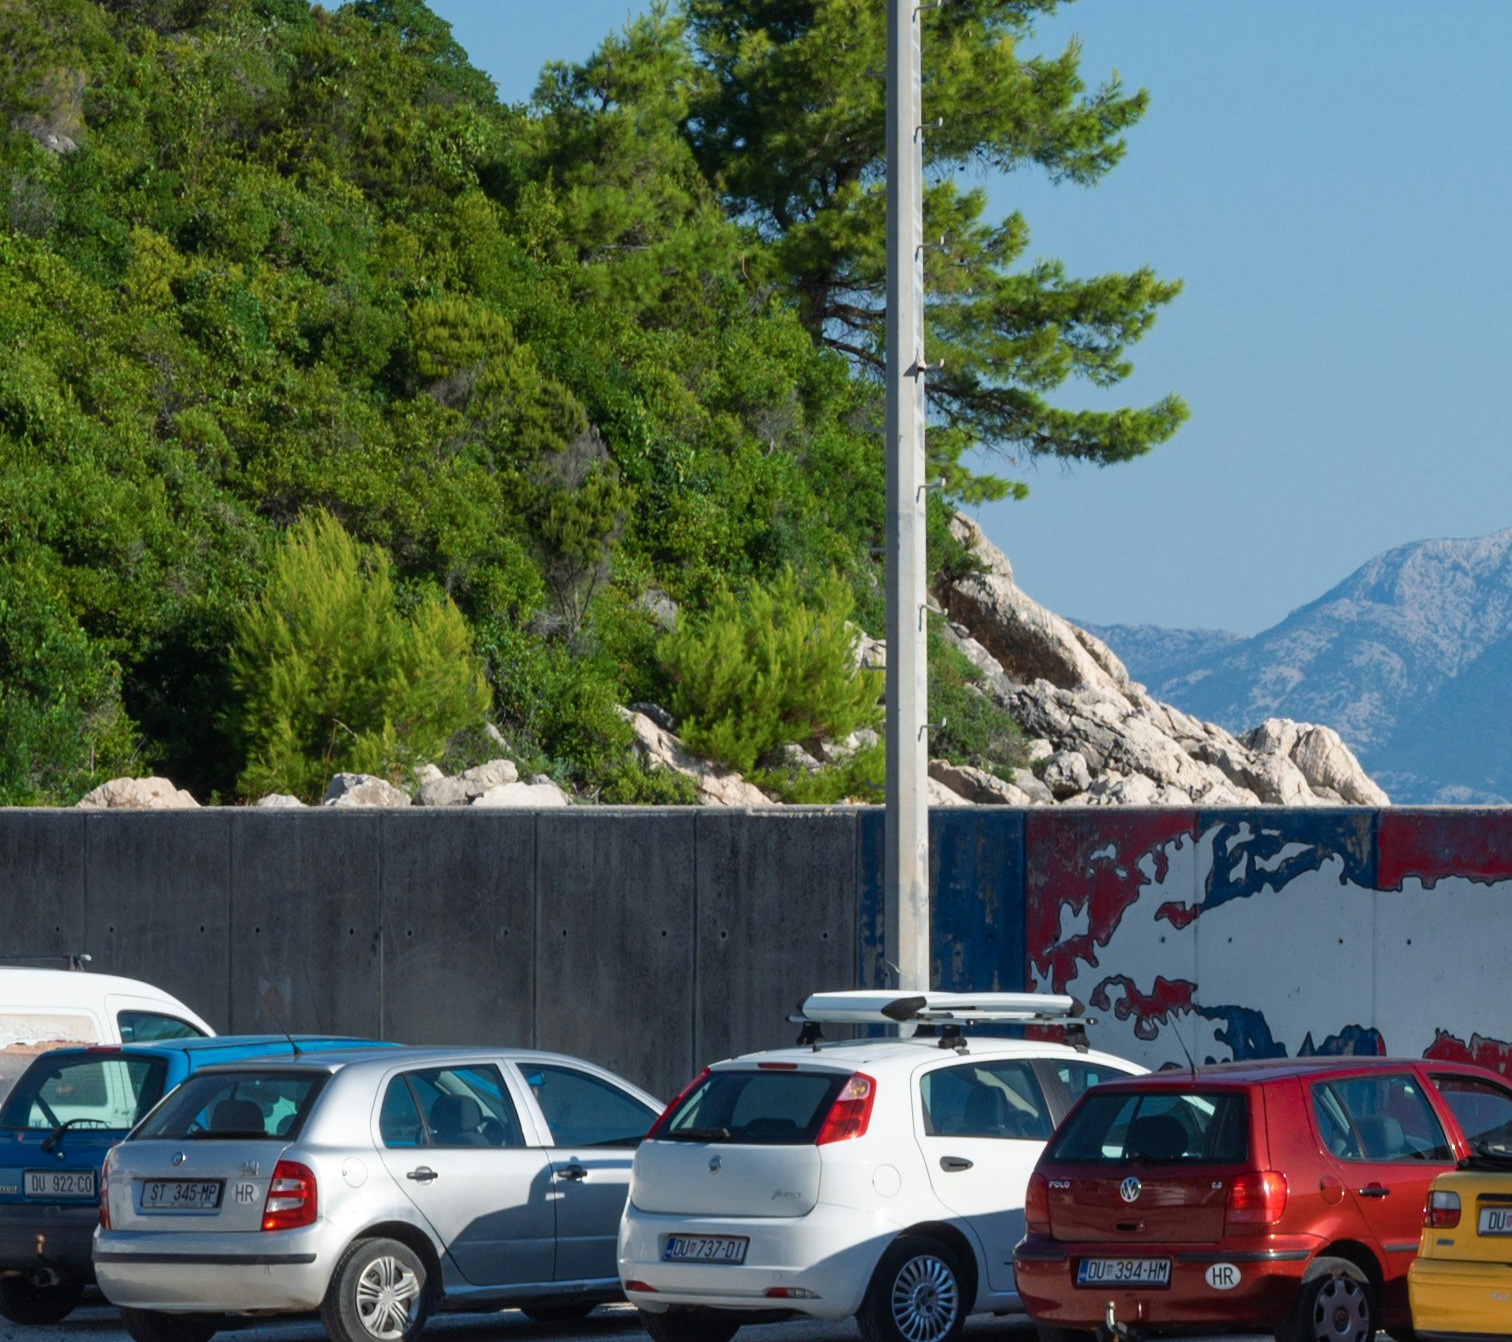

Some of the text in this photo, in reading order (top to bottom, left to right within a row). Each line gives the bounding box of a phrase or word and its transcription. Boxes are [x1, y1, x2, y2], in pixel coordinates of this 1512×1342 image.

[32, 1175, 92, 1193] DU 922-CO
[150, 1184, 217, 1202] ST 345-MP
[235, 1185, 254, 1202] HR
[1489, 1211, 1506, 1230] DU
[673, 1239, 743, 1258] DU 737-DI
[1088, 1261, 1168, 1280] DU 394-HM
[1212, 1267, 1234, 1285] HR
